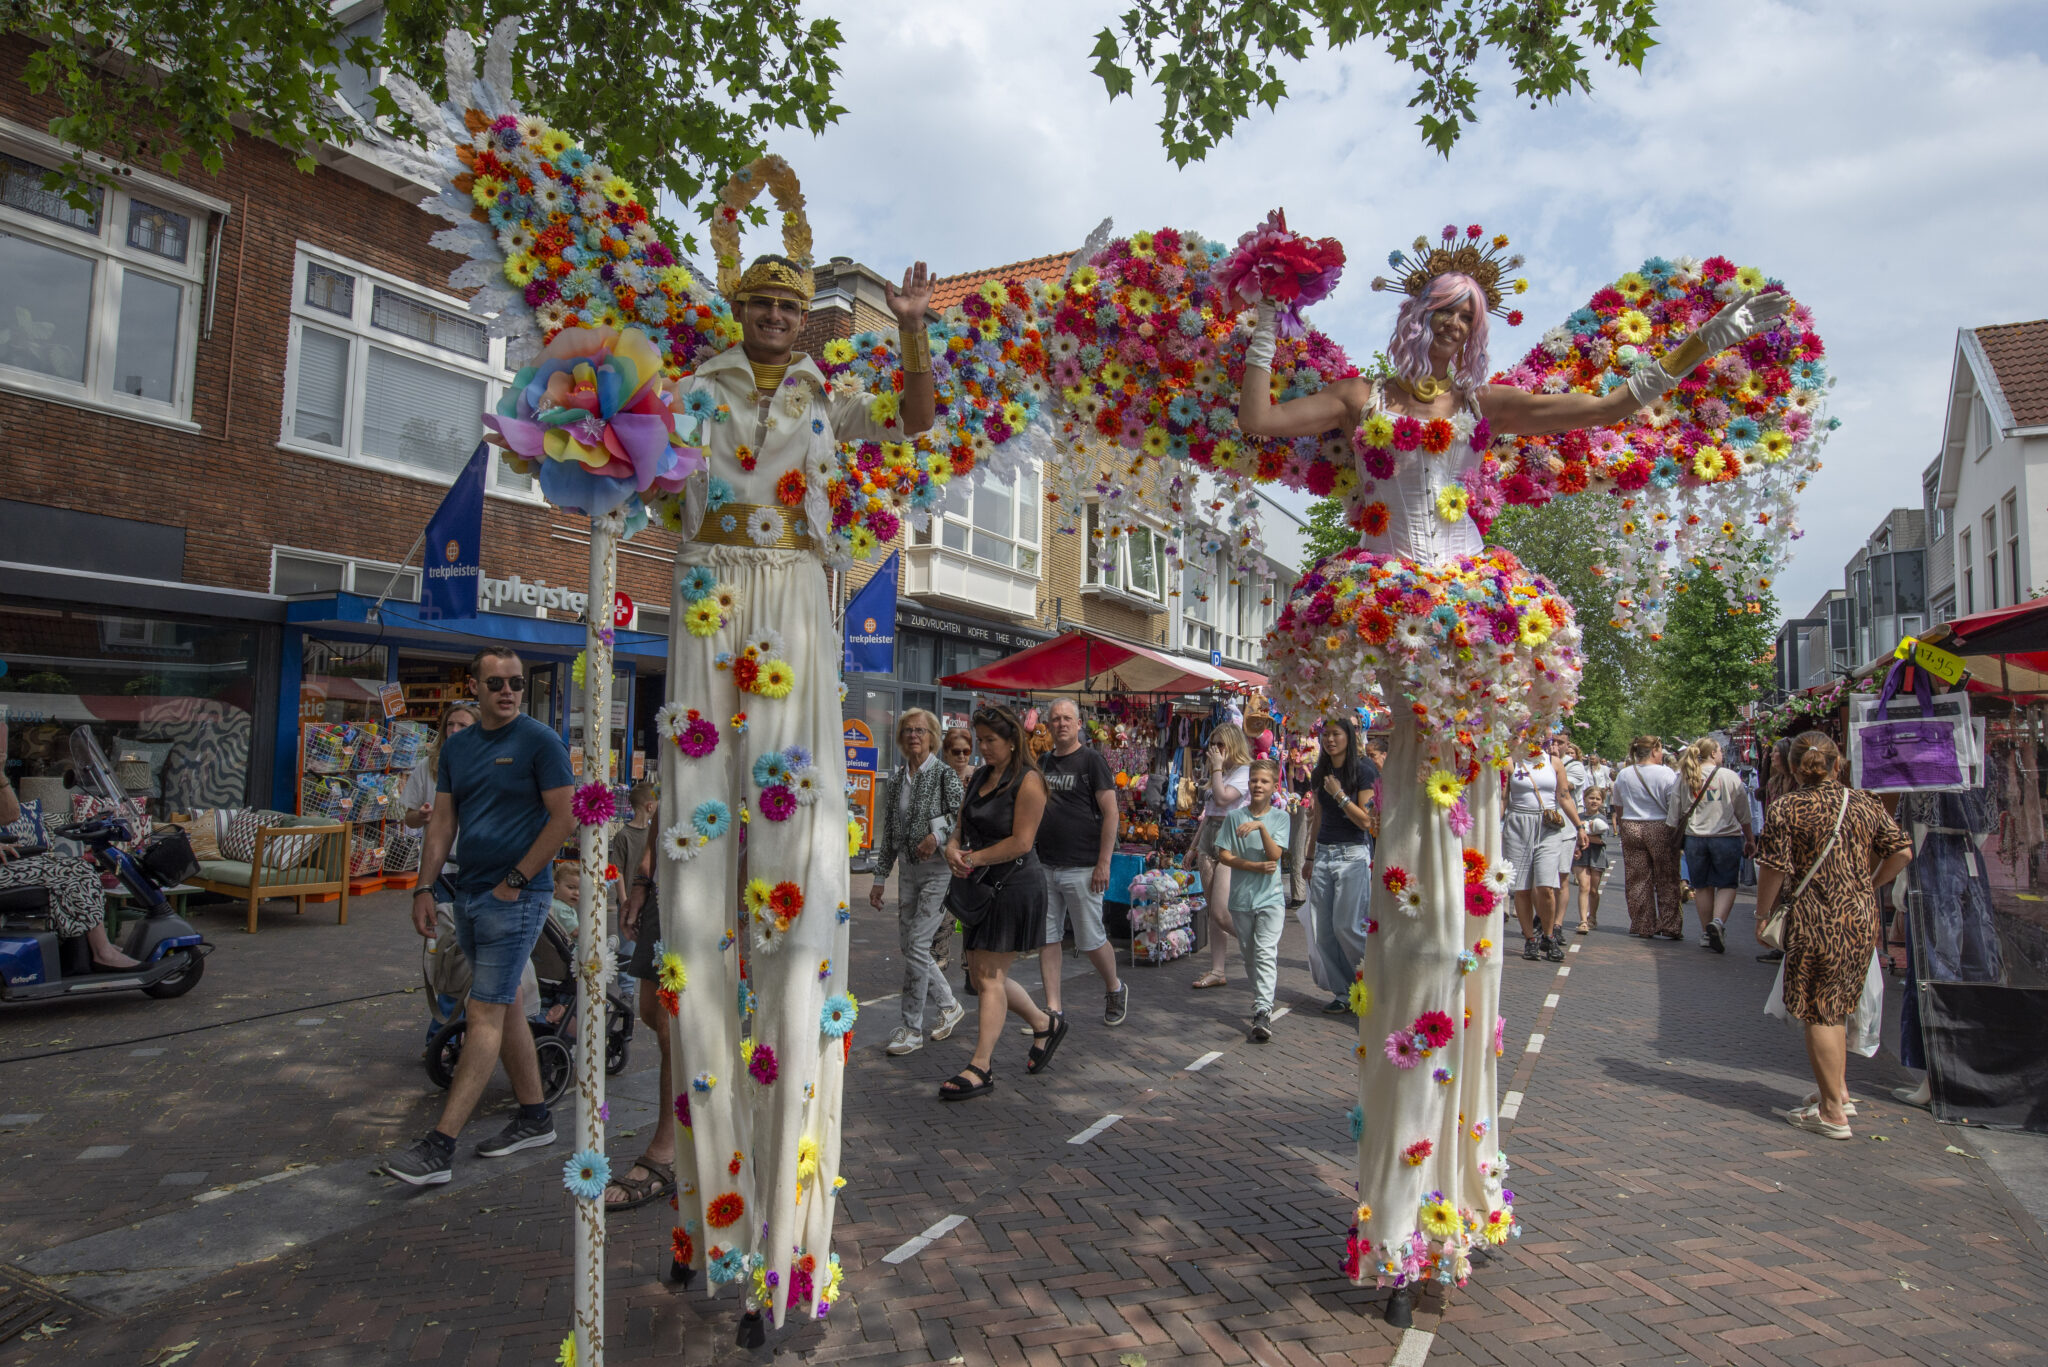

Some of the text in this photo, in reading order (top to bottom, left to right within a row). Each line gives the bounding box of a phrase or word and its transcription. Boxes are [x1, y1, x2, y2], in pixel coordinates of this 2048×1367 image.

[429, 563, 479, 580] trekpleister
[478, 569, 589, 613] kpleiste
[911, 614, 961, 634] ZUIDVRUCHTEN
[967, 626, 989, 640] KOFFIE
[995, 632, 1010, 644] THEE
[849, 634, 894, 645] trekpleister
[1214, 654, 1220, 666] P
